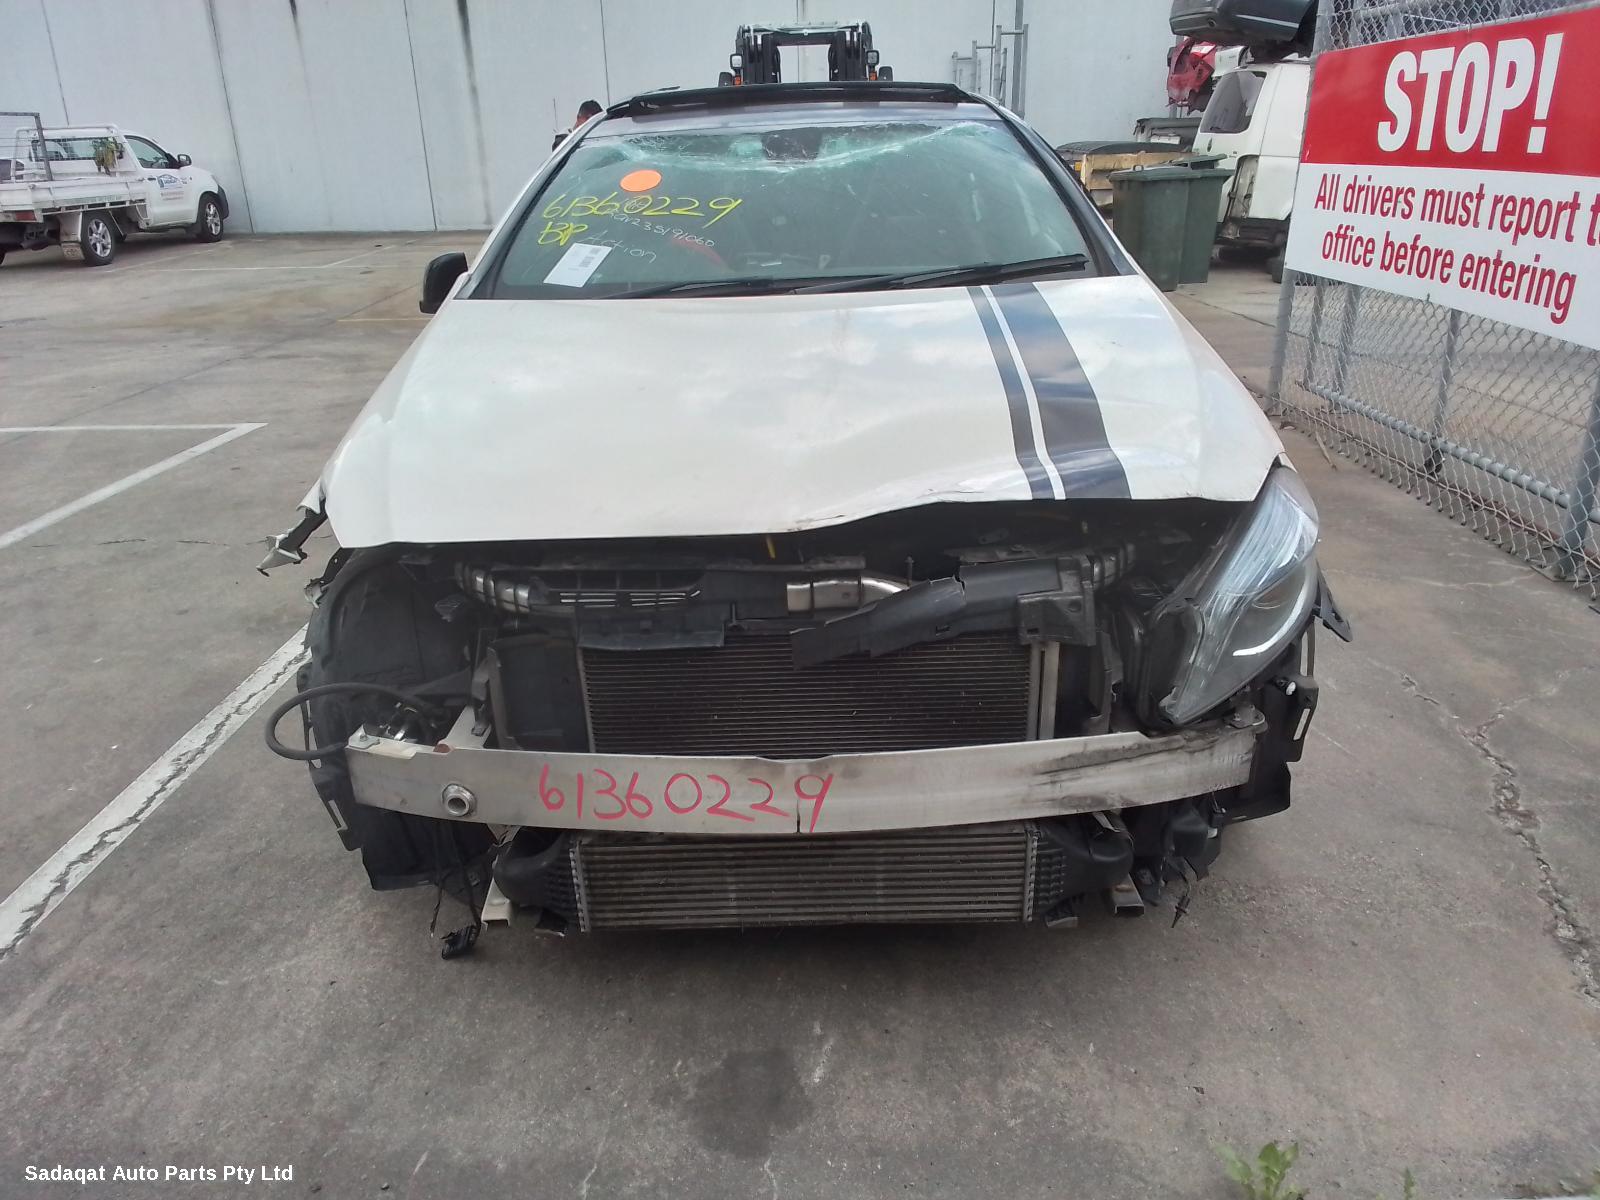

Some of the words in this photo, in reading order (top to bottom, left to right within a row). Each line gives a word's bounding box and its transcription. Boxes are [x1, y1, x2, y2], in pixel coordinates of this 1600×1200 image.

[1377, 33, 1564, 154] STOP!
[1314, 173, 1340, 210] All
[1343, 175, 1415, 220] drivers
[1420, 183, 1485, 228] must
[1488, 191, 1581, 246] report
[1586, 193, 1600, 246] t
[1322, 224, 1376, 268] office
[1380, 231, 1455, 284] before
[1458, 249, 1576, 325] entering
[538, 763, 834, 833] 61360229
